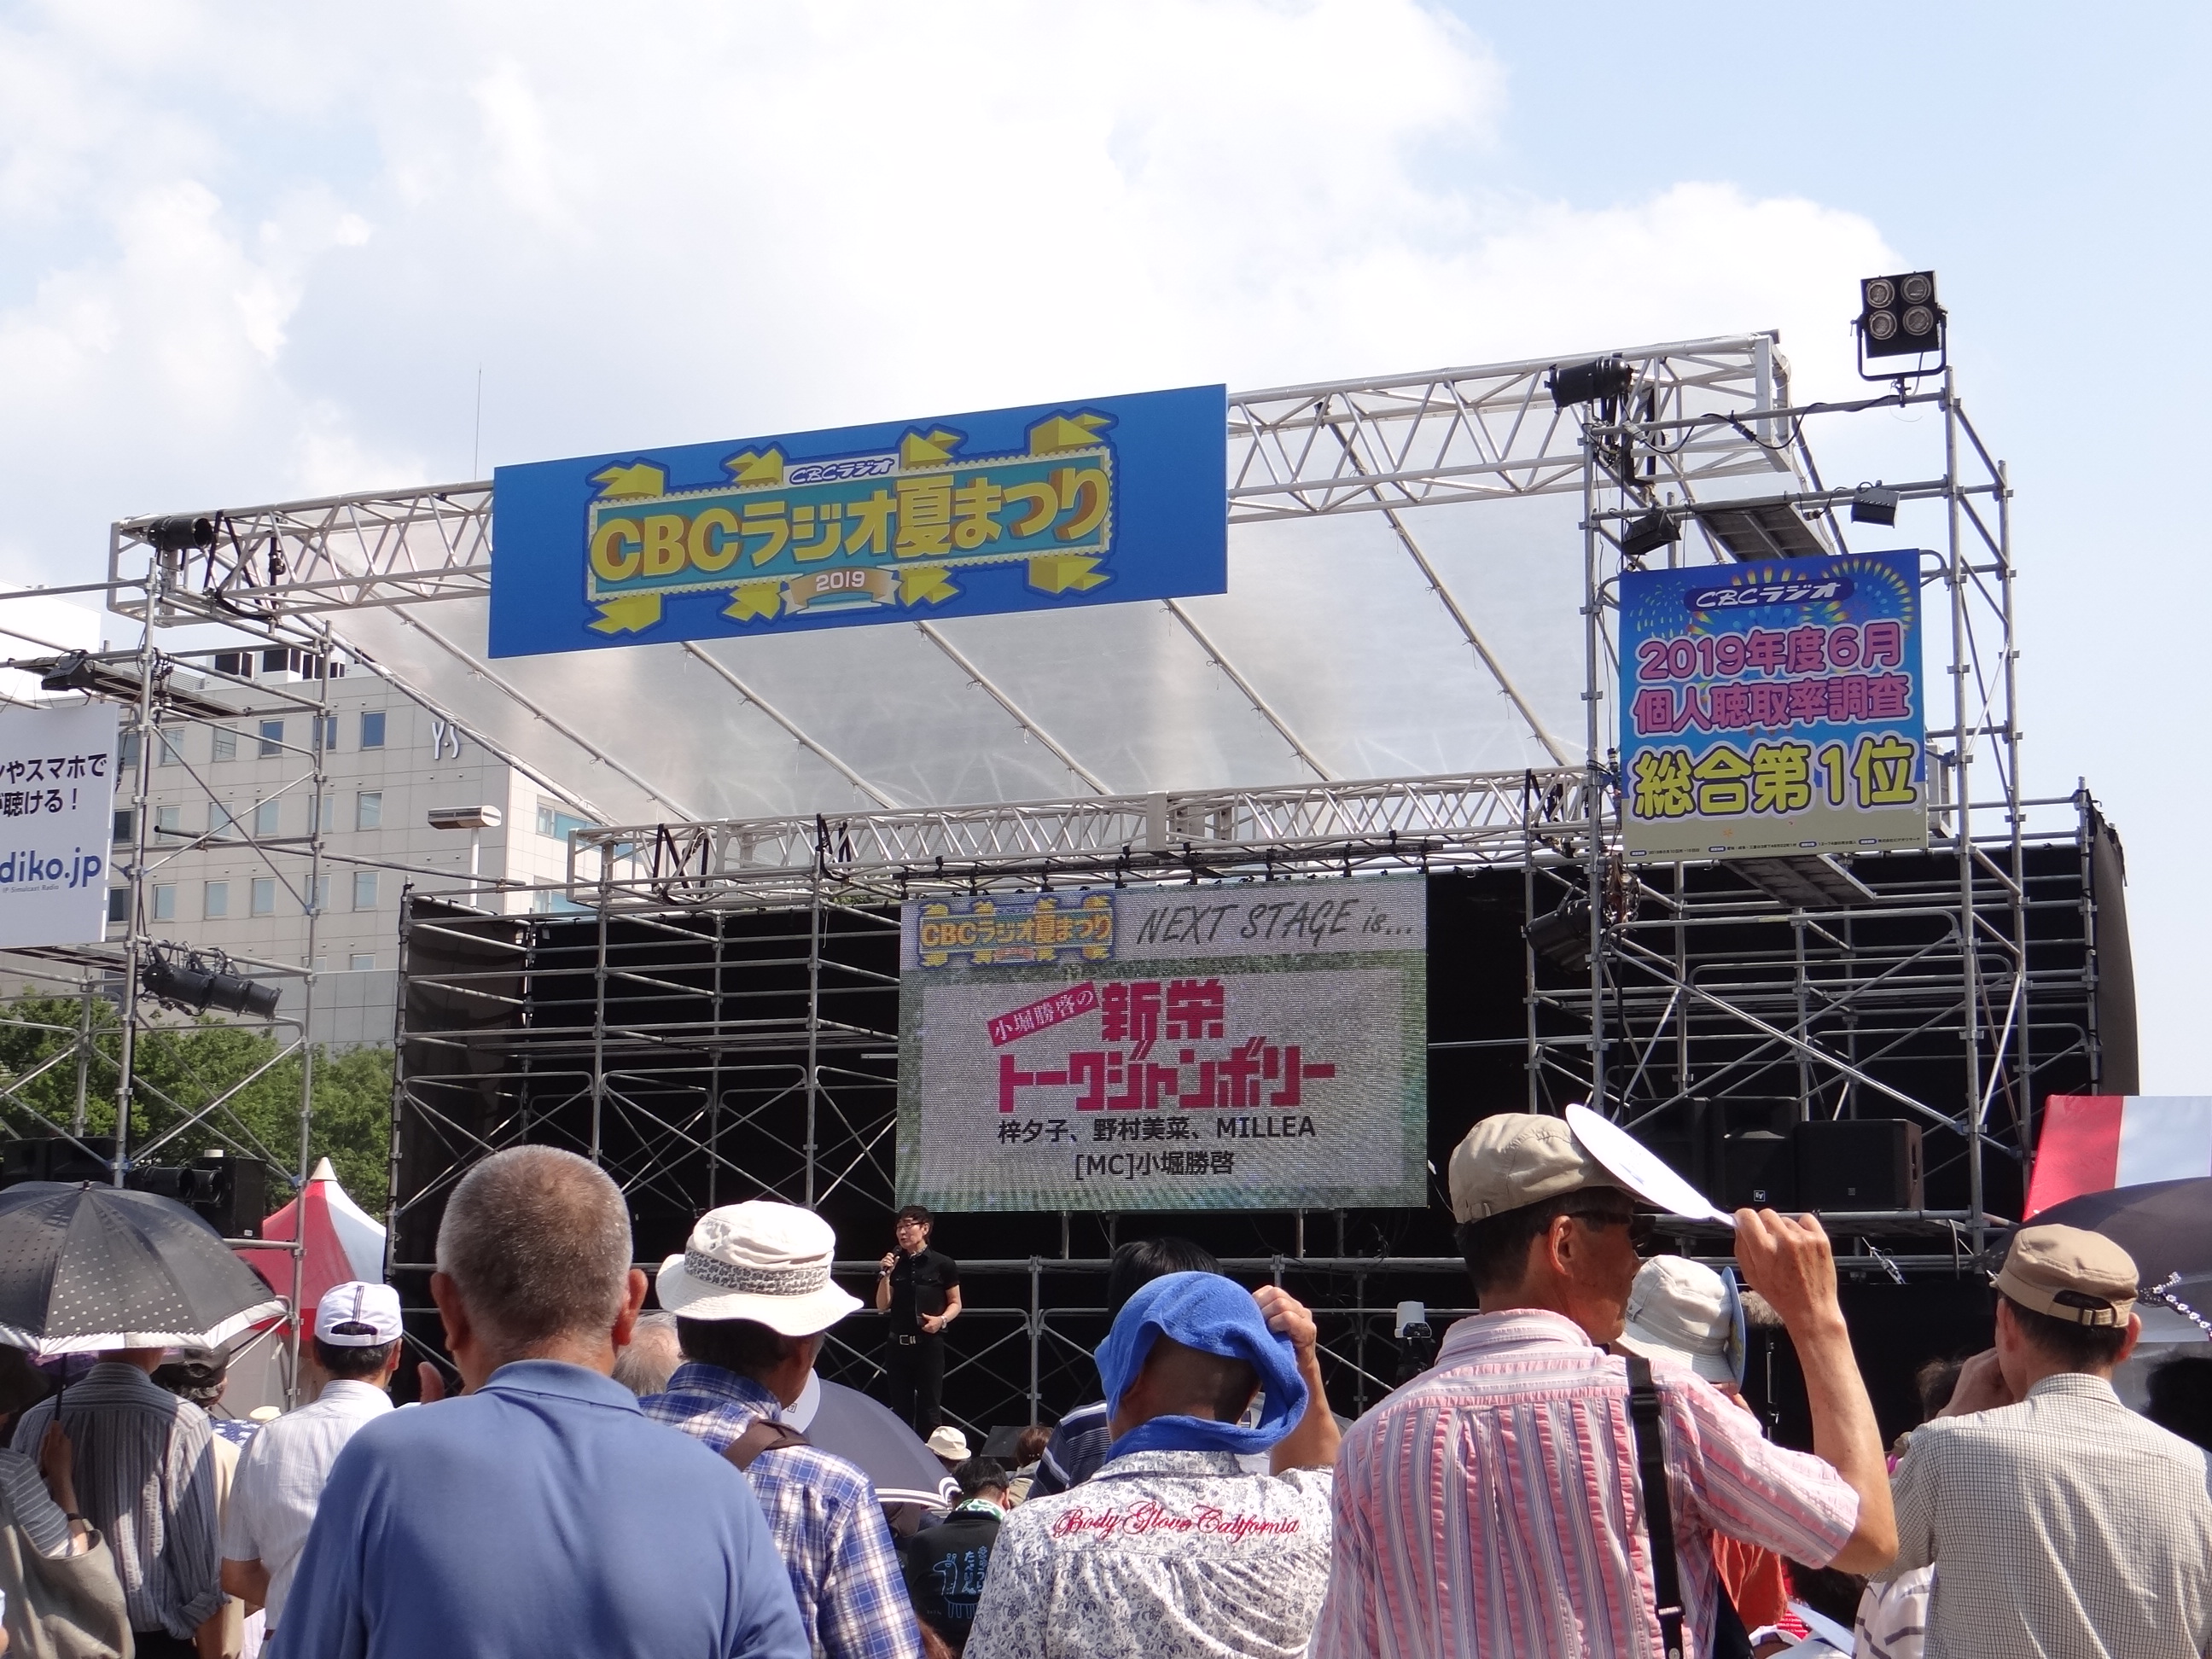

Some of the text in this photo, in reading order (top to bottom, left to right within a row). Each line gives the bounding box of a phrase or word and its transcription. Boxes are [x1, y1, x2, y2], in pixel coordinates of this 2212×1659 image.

[790, 459, 894, 485] CBCラジオ
[590, 469, 1110, 582] CBCラジオ夏まつり
[816, 571, 865, 591] 2019
[1695, 582, 1841, 608] CBCラジオ
[1638, 622, 1902, 680] 2019年度6月
[1633, 672, 1910, 735] 個人聴取率調査
[1633, 735, 1918, 820] 総合第1位
[0, 847, 102, 888] diko.jp
[921, 913, 1111, 946] CBCラジオ夏まつり
[1136, 904, 1238, 945] NEXT
[1240, 898, 1359, 947] STAGE
[994, 990, 1094, 1040] 小堀勝啓の
[1102, 978, 1224, 1042] 新栄
[998, 1035, 1336, 1113] トークジャンボリー
[1074, 1150, 1235, 1180] [MC]小堀勝啓
[1052, 1500, 1300, 1544] Body Glove California
